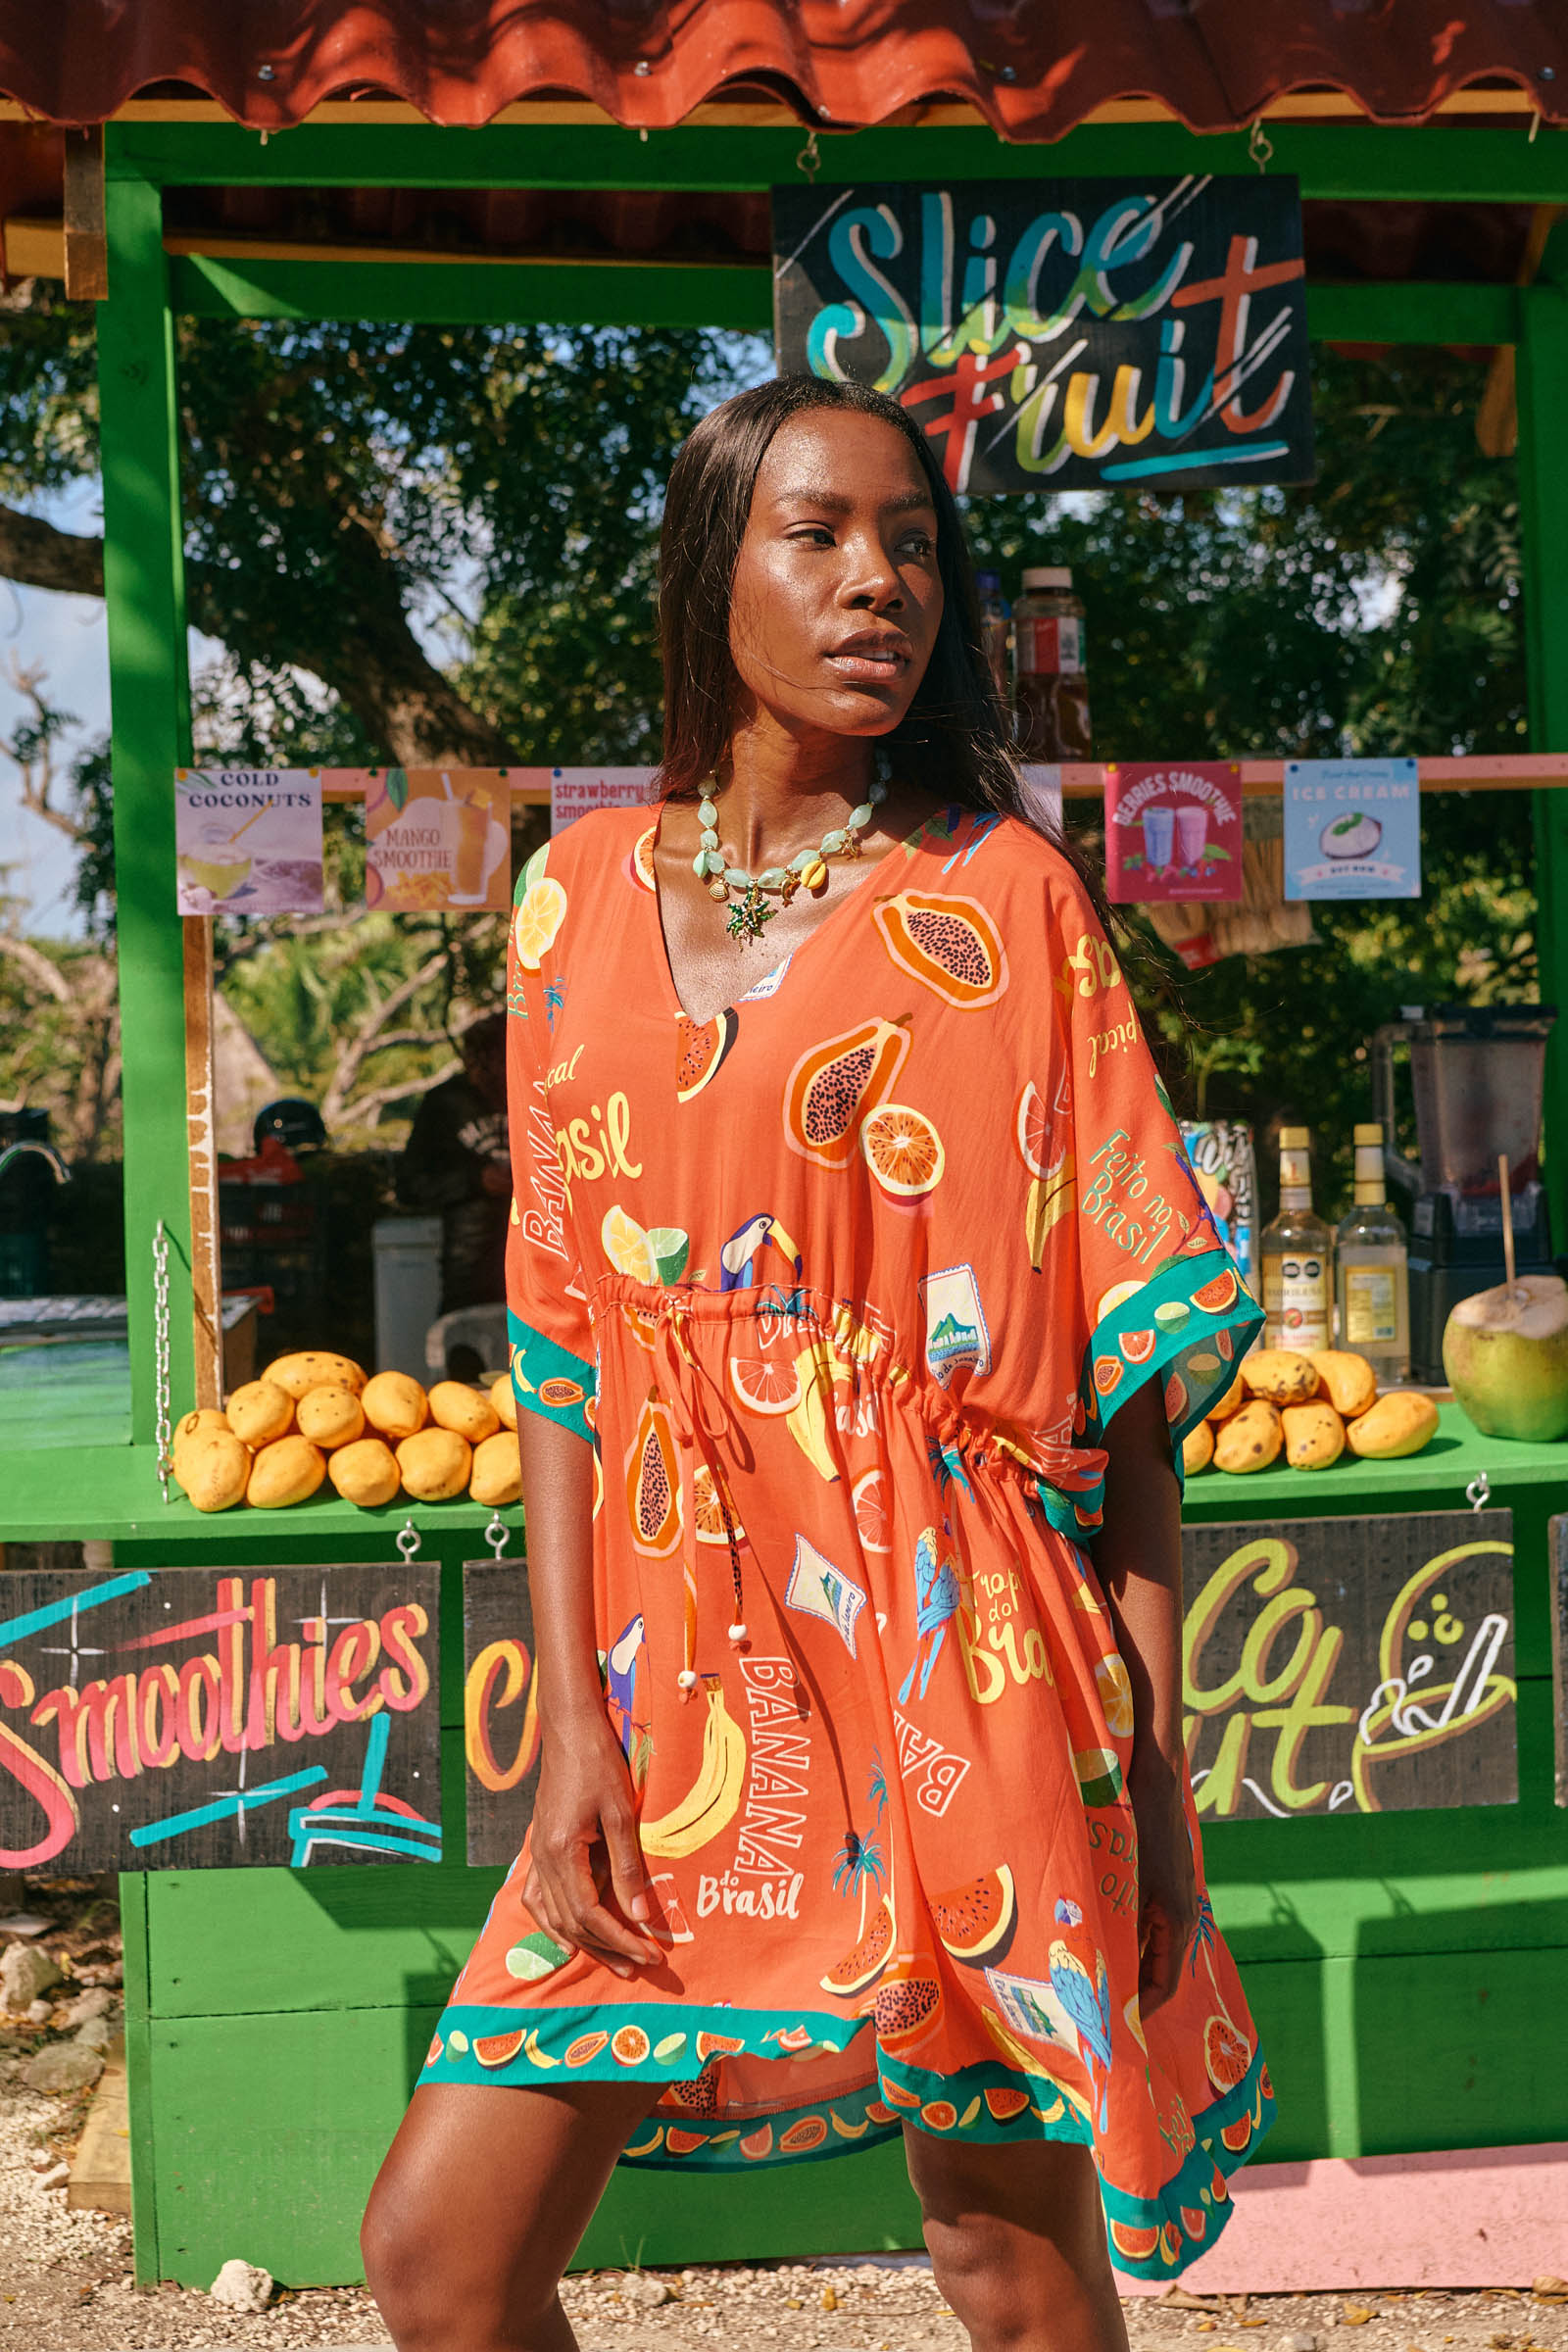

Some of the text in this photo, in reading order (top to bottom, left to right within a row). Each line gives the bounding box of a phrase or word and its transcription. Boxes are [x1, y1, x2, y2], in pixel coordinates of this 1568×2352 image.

[808, 189, 1195, 394] Slice
[899, 234, 1305, 492] Fruit
[220, 772, 279, 787] COLD
[556, 779, 645, 804] strawberry
[188, 794, 312, 808] COCONUTS
[1112, 770, 1237, 826] BERRIES SMOOTHIE
[1293, 784, 1410, 801] ICE CREAM
[386, 828, 441, 848] MANGO
[373, 850, 452, 869] SMOOTHIE
[1090, 1129, 1173, 1225] Feito no
[1082, 1170, 1171, 1264] Brasil
[989, 1599, 1012, 1623] do
[734, 1656, 811, 1877] BANANA
[719, 1870, 739, 1887] do
[696, 1873, 805, 1920] Brasil
